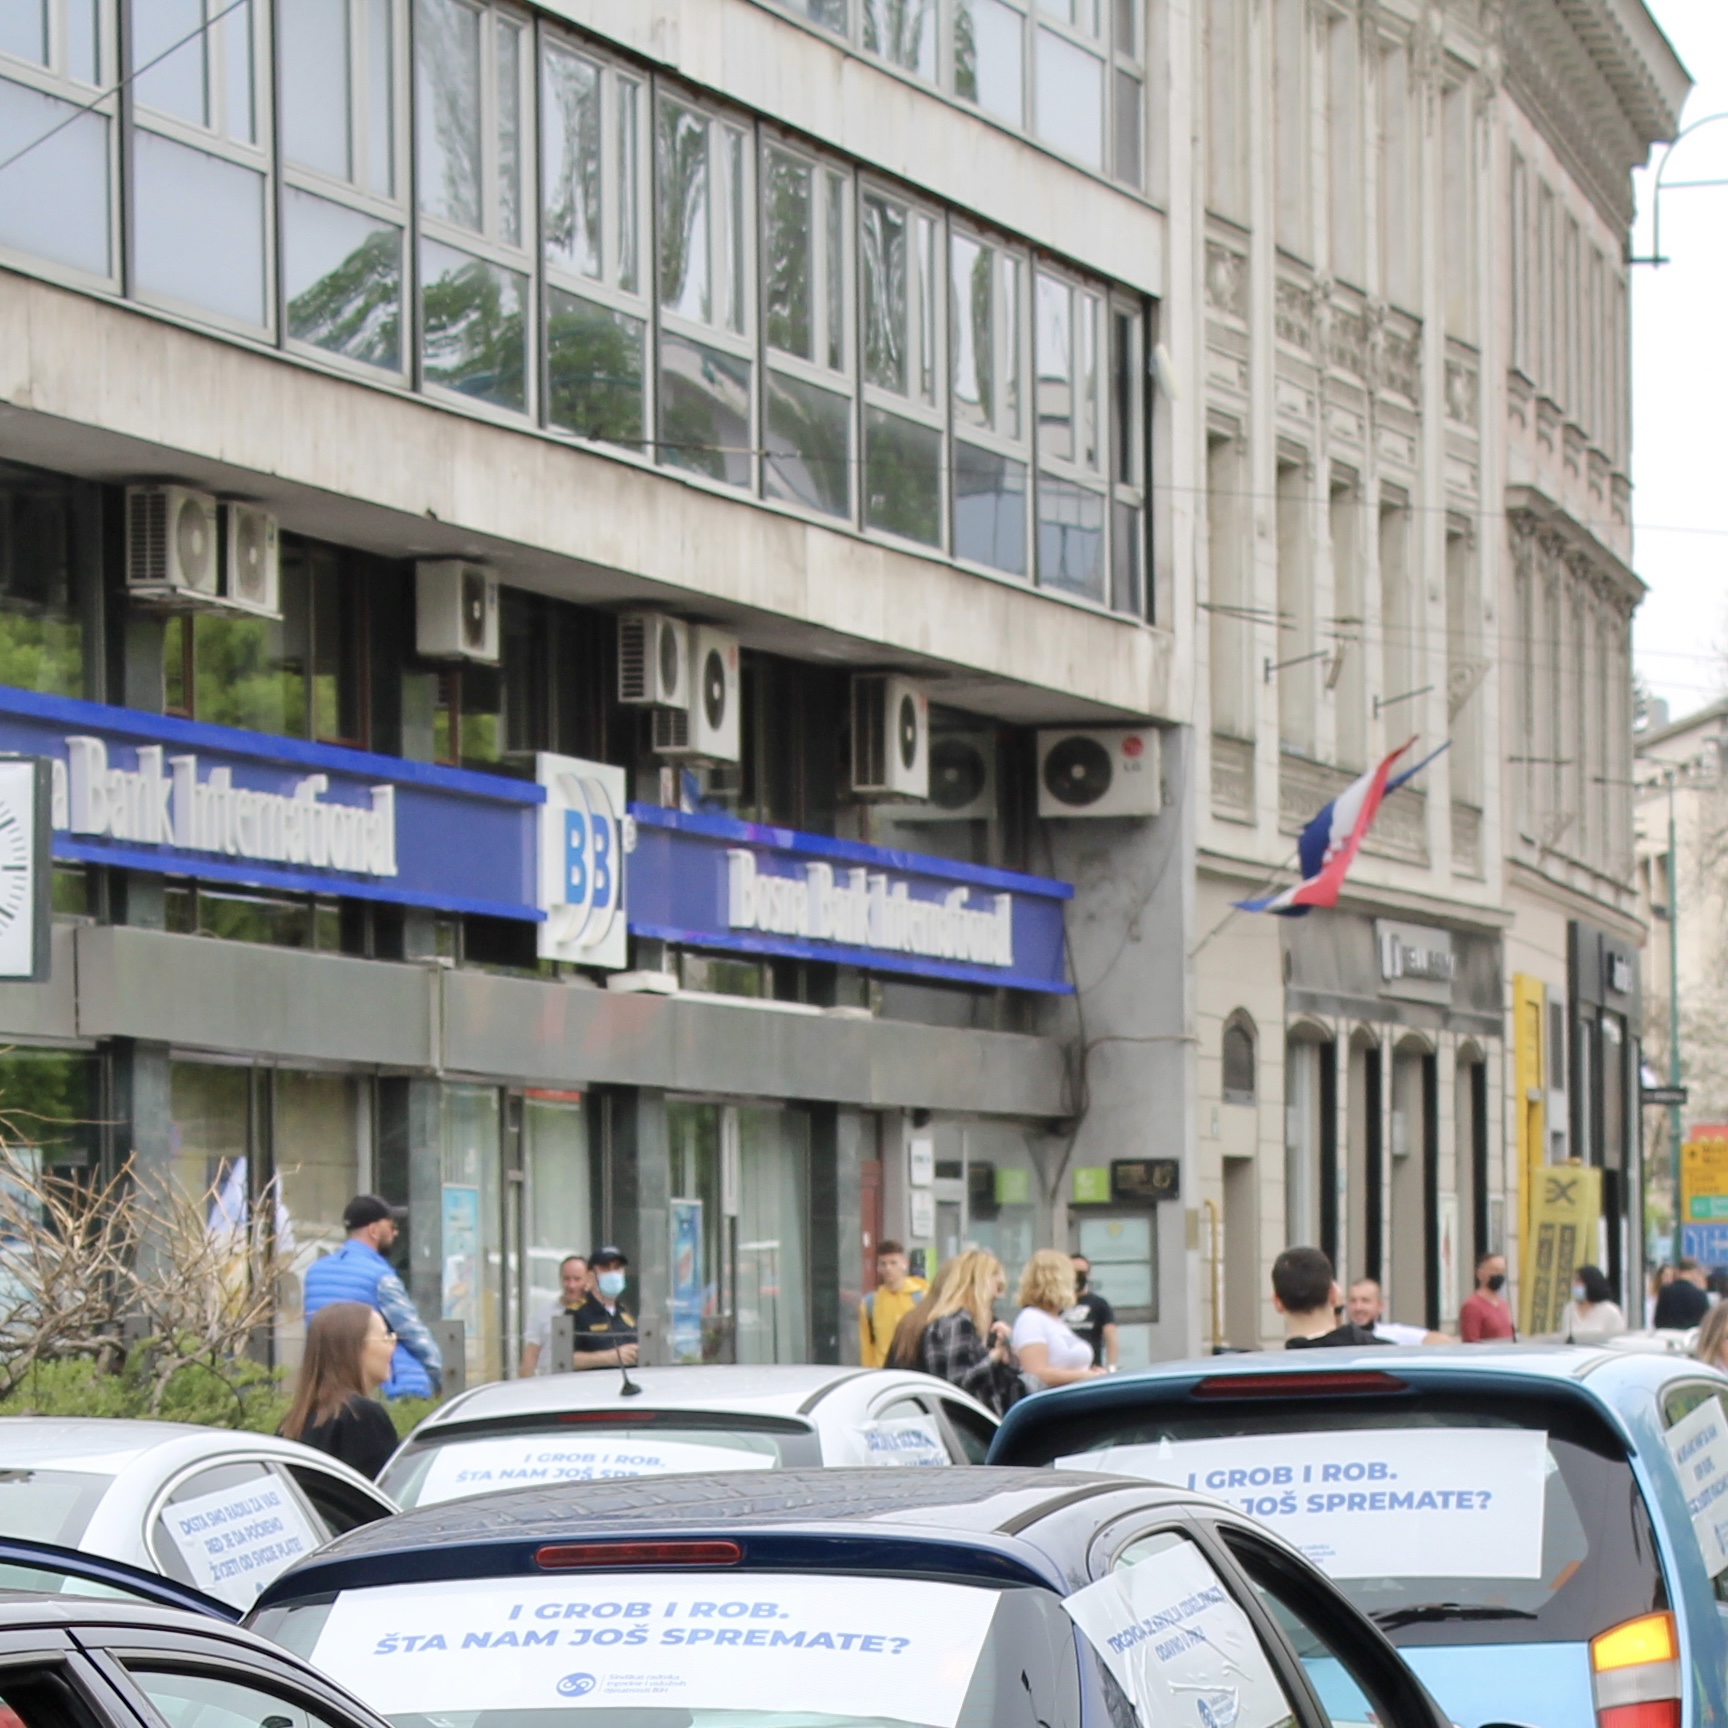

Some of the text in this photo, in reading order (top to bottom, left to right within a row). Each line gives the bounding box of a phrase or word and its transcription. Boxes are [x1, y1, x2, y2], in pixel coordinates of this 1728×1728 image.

[66, 736, 172, 844] Bank
[168, 755, 398, 876] International
[536, 1452, 596, 1464] GROB
[614, 1453, 667, 1468] ROB.
[455, 1469, 492, 1484] ŠTA
[498, 1468, 548, 1481] NAM
[1187, 1461, 1399, 1491] I GROB I ROB.
[1239, 1489, 1493, 1516] JOŠ SPREMATE?
[203, 1535, 224, 1556] RED
[508, 1600, 791, 1621] I GROB I ROB.
[373, 1623, 912, 1656] ŠTA NAM JOŠ SPREMATE?
